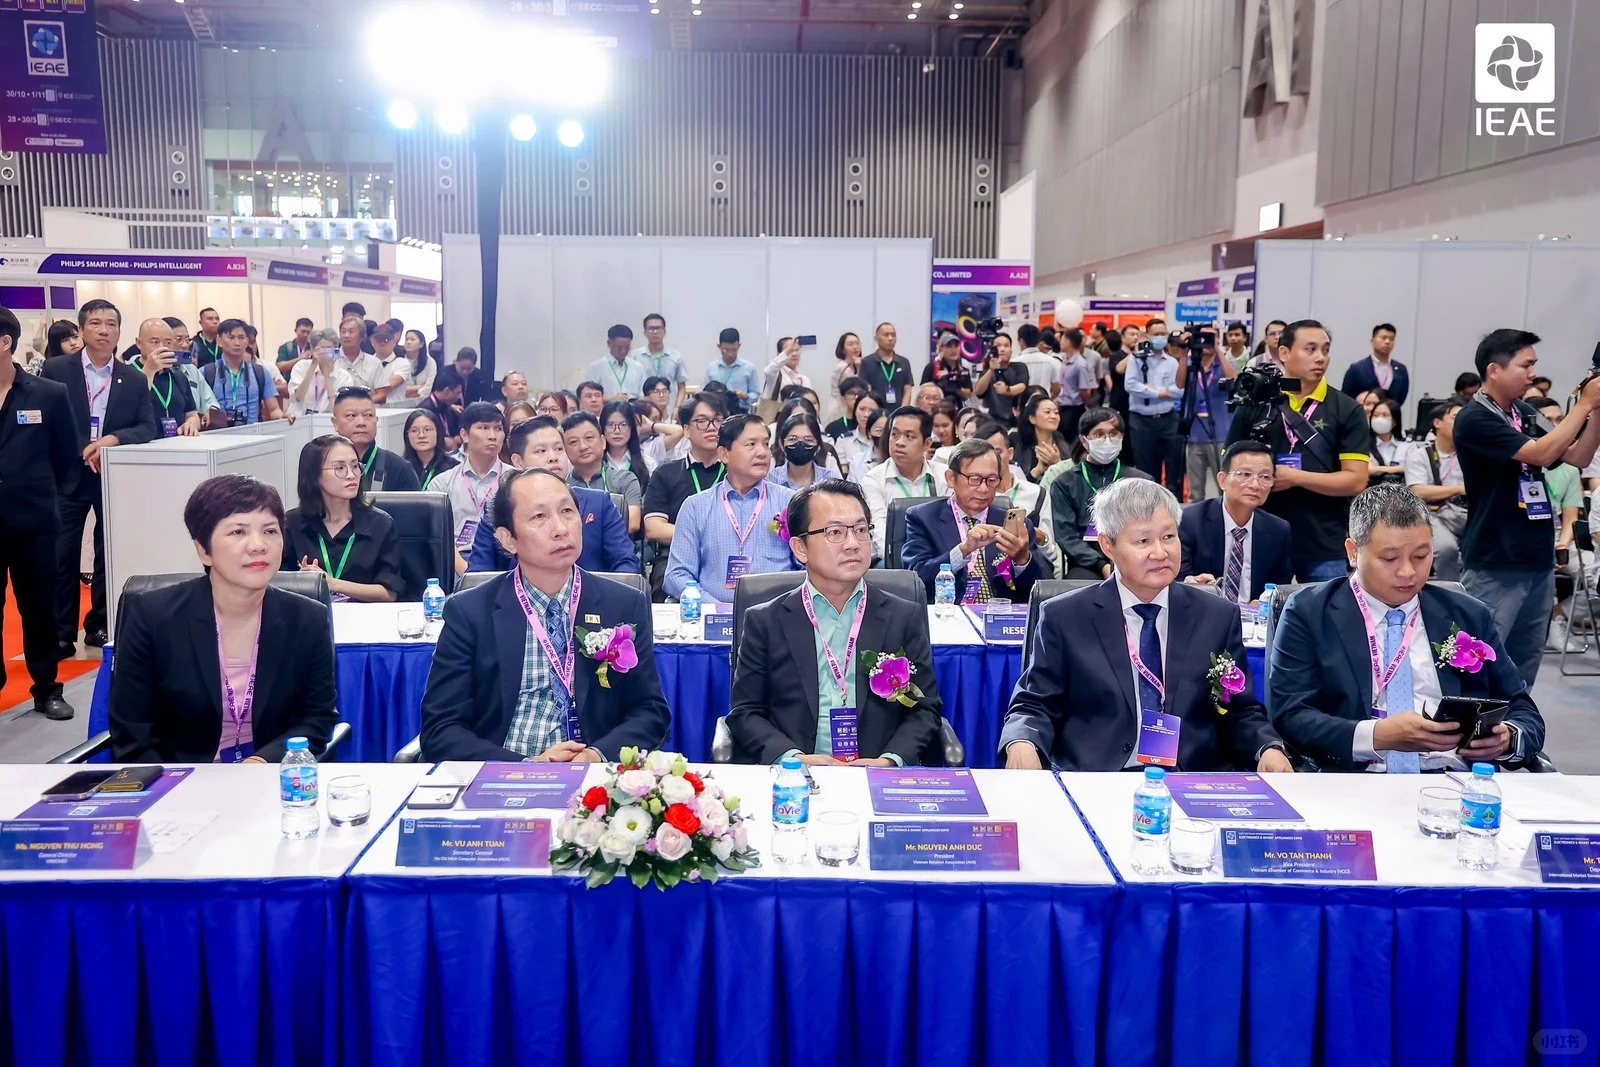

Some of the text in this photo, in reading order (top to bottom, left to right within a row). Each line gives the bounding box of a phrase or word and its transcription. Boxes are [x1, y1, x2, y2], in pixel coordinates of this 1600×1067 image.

[30, 62, 66, 74] IEAE
[6, 90, 26, 98] 30/10
[7, 115, 17, 123] 28
[520, 594, 534, 616] VIETNAM
[1369, 635, 1378, 655] VIETNAM
[829, 656, 842, 680] VIETNAM
[1384, 663, 1396, 683] VIETNAM
[1143, 668, 1161, 688] VIETNAM
[80, 842, 104, 850] HONG
[441, 840, 505, 848] Mr. VU ANH TUAN
